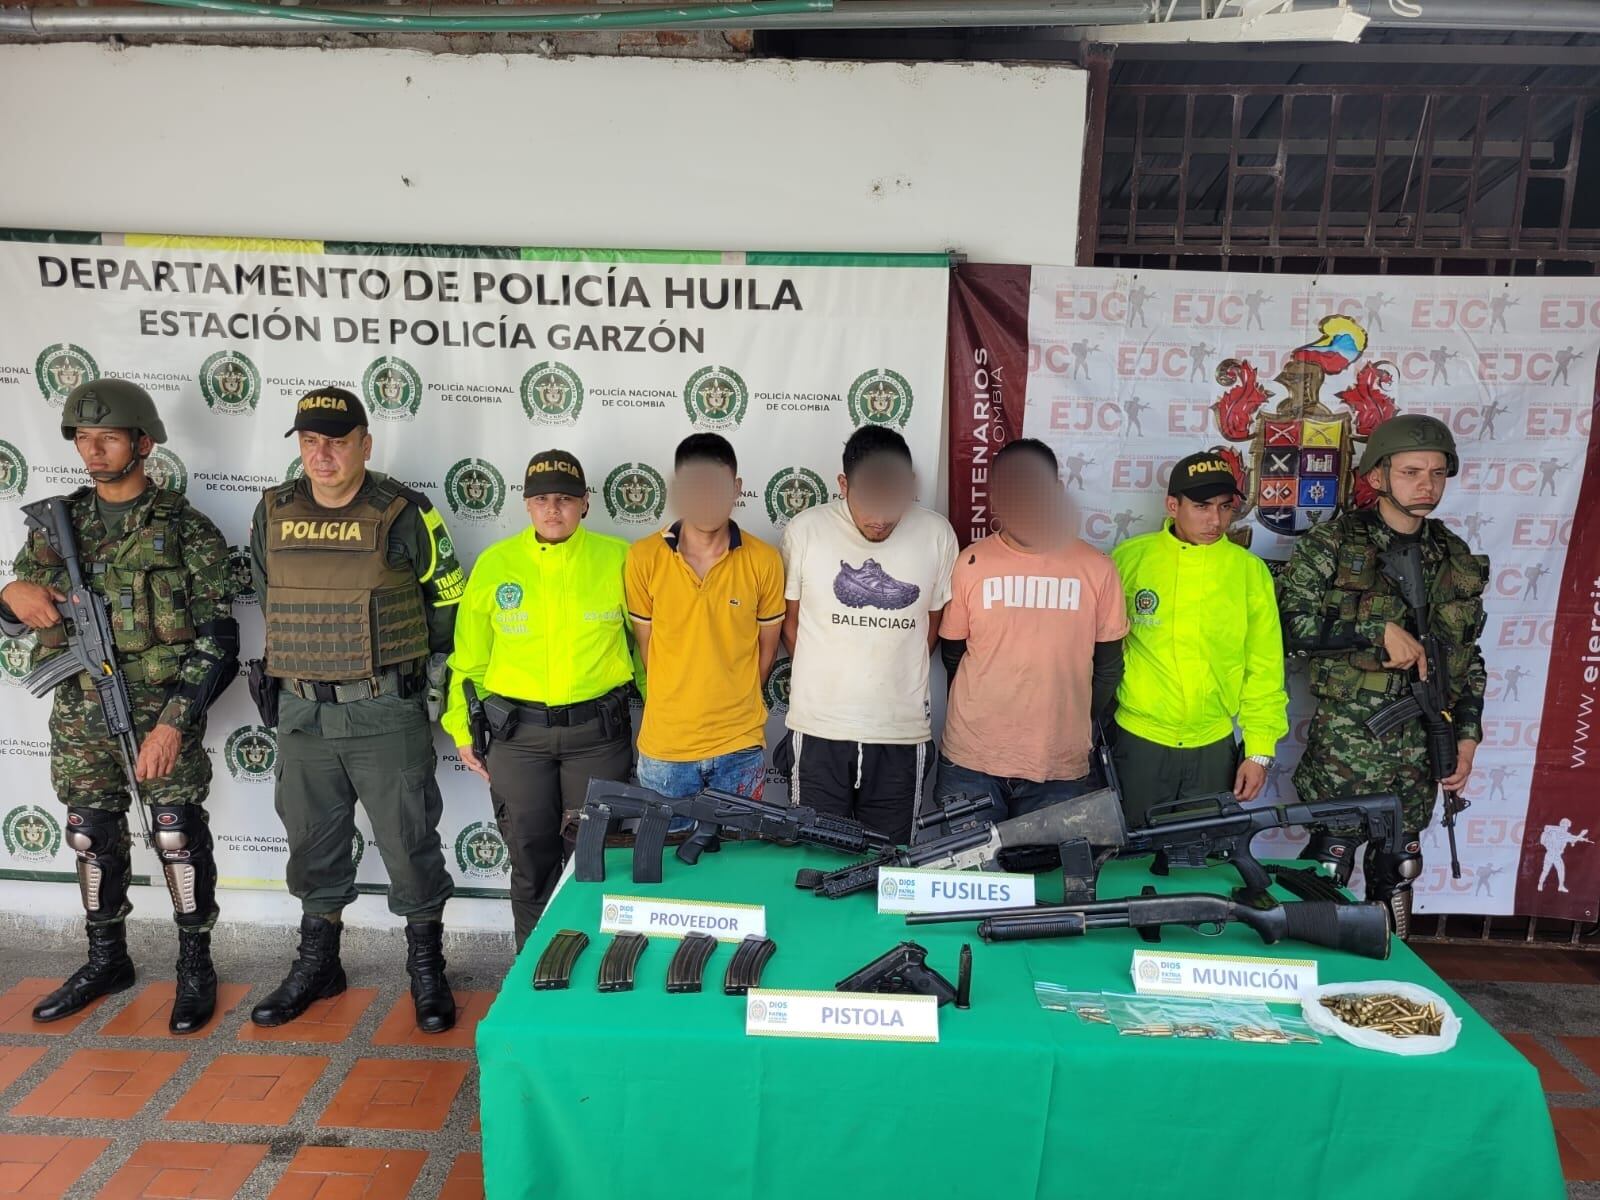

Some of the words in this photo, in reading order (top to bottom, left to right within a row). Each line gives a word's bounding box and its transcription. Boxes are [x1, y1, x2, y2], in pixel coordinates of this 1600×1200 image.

[38, 255, 391, 301] DEPARTAMENTO
[403, 269, 459, 302] DE
[473, 266, 651, 308] POLICÍA
[665, 277, 803, 311] HUILA
[1056, 291, 1127, 321] EJC
[1173, 295, 1244, 325] EJC
[1412, 299, 1487, 329] EJC
[139, 306, 321, 342] ESTACIÓN
[334, 317, 380, 344] DE
[390, 315, 536, 350] POLICÍA
[547, 319, 704, 353] GARZÓN
[1117, 347, 1188, 376] EJC
[1478, 352, 1553, 381] EJC
[104, 370, 140, 380] POLICÍA
[143, 372, 192, 382] NACIONAL
[266, 376, 305, 386] POLICÍA
[308, 378, 357, 388] NACIONAL
[428, 382, 464, 392] POLICÍA
[467, 384, 515, 394] NACIONAL
[590, 387, 626, 397] POLICÍA
[629, 389, 677, 398] NACIONAL
[754, 391, 791, 401] POLICÍA
[794, 393, 842, 402] NACIONAL
[298, 396, 347, 413] POLICIA
[441, 394, 453, 402] DE
[456, 395, 502, 403] COLOMBIA
[602, 399, 615, 407] DE
[617, 400, 665, 408] COLOMBIA
[766, 403, 779, 411] DE
[781, 404, 830, 412] COLOMBIA
[1050, 402, 1122, 431] EJC
[33, 465, 69, 475] POLICÍA
[527, 460, 580, 477] POLICIA
[1461, 463, 1537, 491] EJC
[194, 472, 229, 482] POLICÍA
[231, 474, 279, 483] NACIONAL
[206, 483, 219, 491] DE
[281, 519, 362, 543] POLICIA
[983, 576, 1081, 610] PUMA
[832, 613, 916, 630] BALENCIAGA
[217, 834, 252, 842] POLICÍA
[243, 845, 288, 853] COLOMBIA
[931, 880, 1011, 902] FUSILES
[650, 912, 738, 931] PROVEEDOR
[1161, 961, 1181, 970] DIOS
[1193, 967, 1298, 990] MUNICIÓN
[769, 1001, 788, 1010] DIOS
[821, 1006, 905, 1027] PISTOLA
